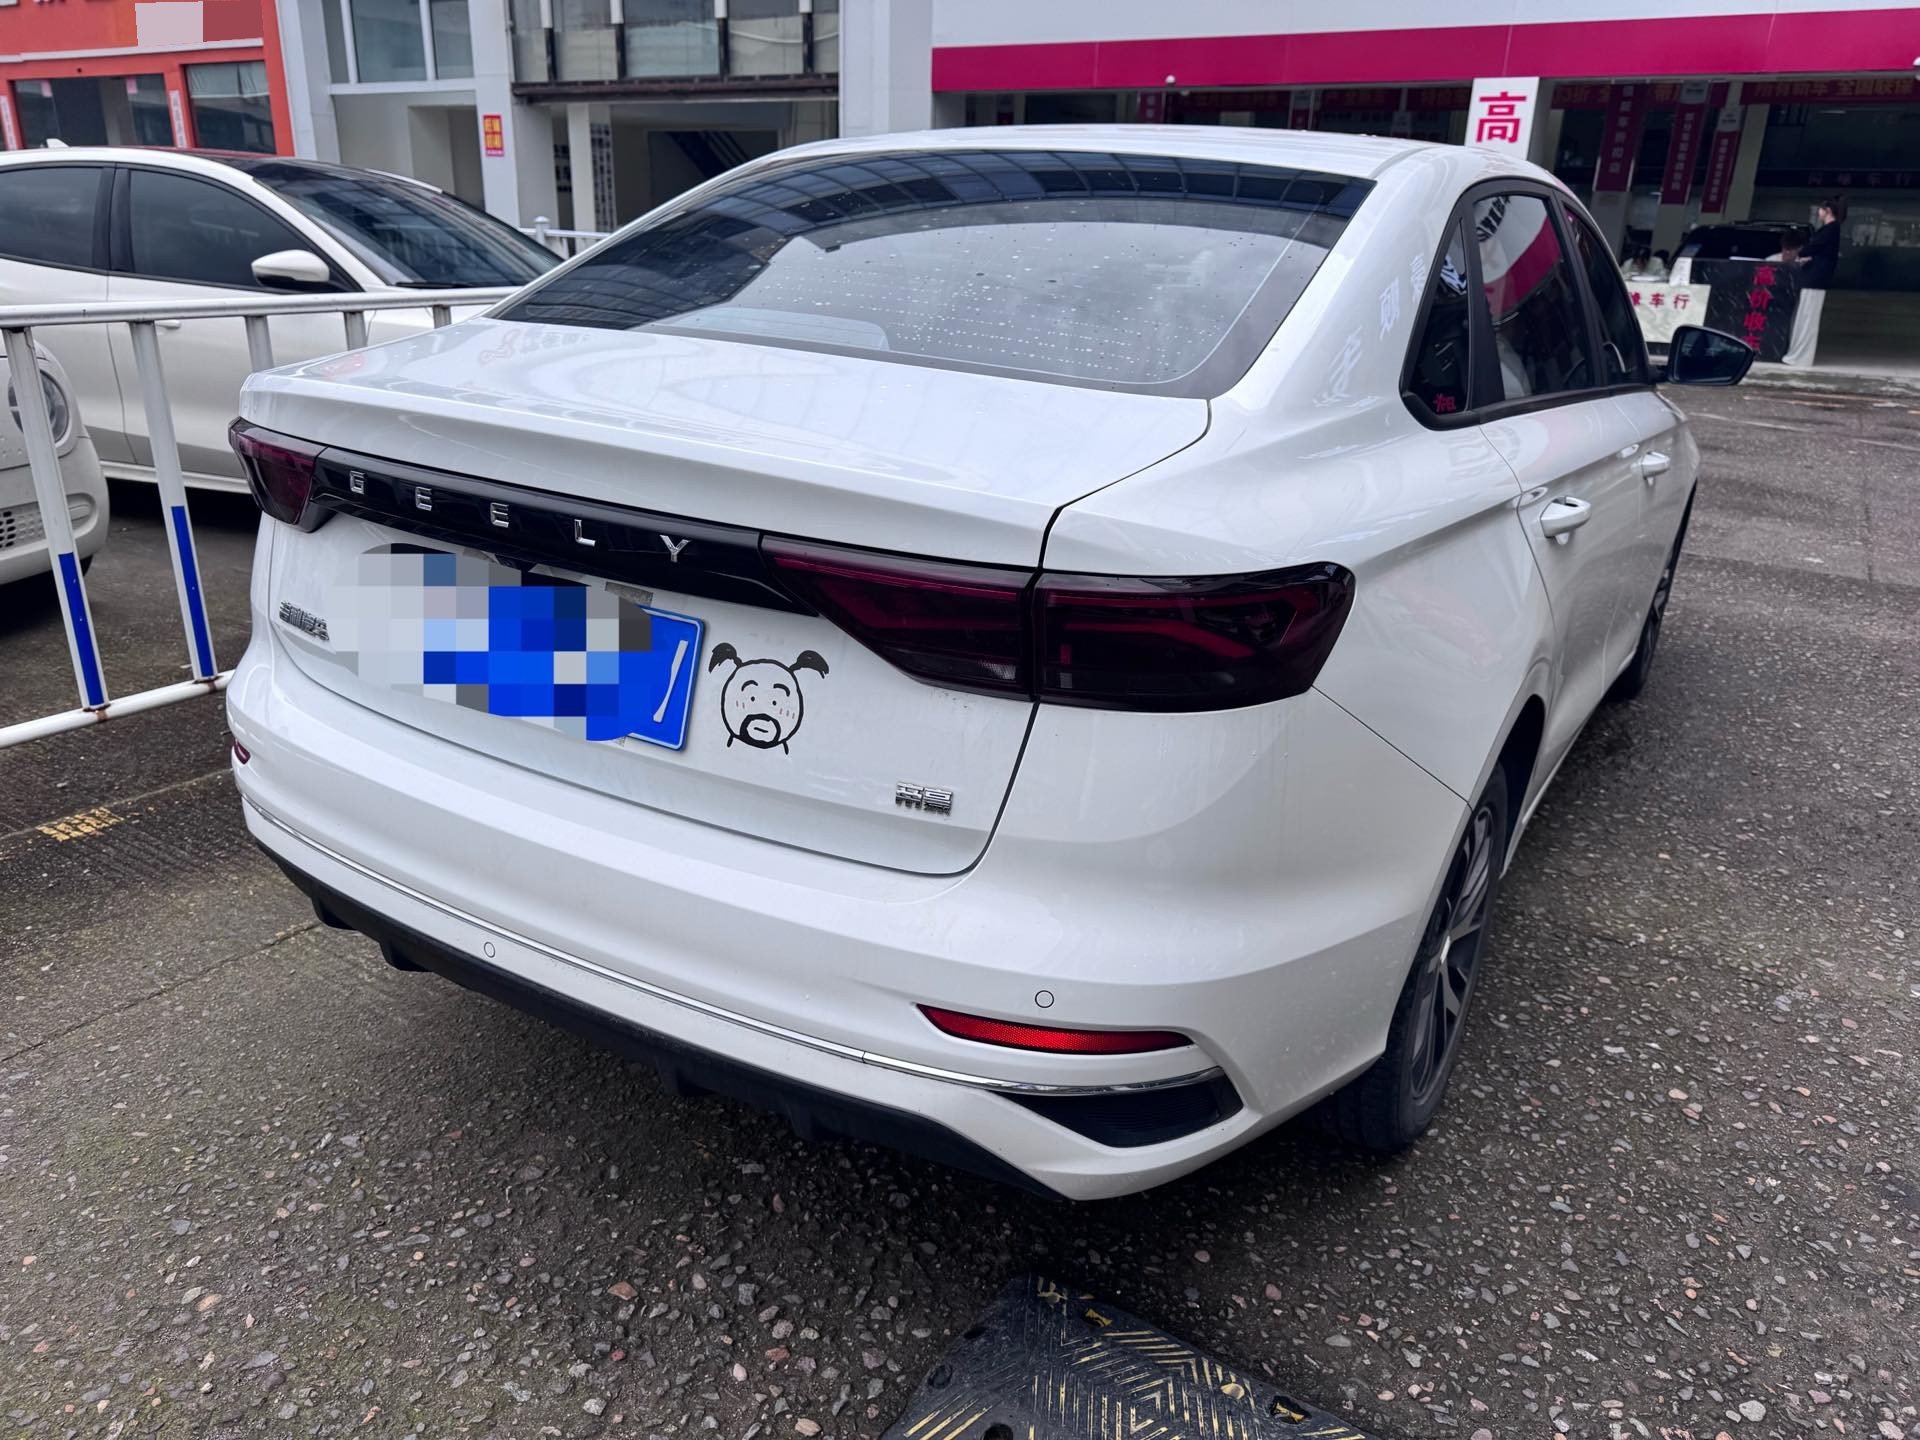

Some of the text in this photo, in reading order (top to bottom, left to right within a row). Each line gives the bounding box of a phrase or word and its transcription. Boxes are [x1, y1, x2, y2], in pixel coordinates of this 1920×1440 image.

[1476, 90, 1527, 144] 高
[348, 470, 691, 564] GEELY
[895, 781, 954, 814] 帝豪
